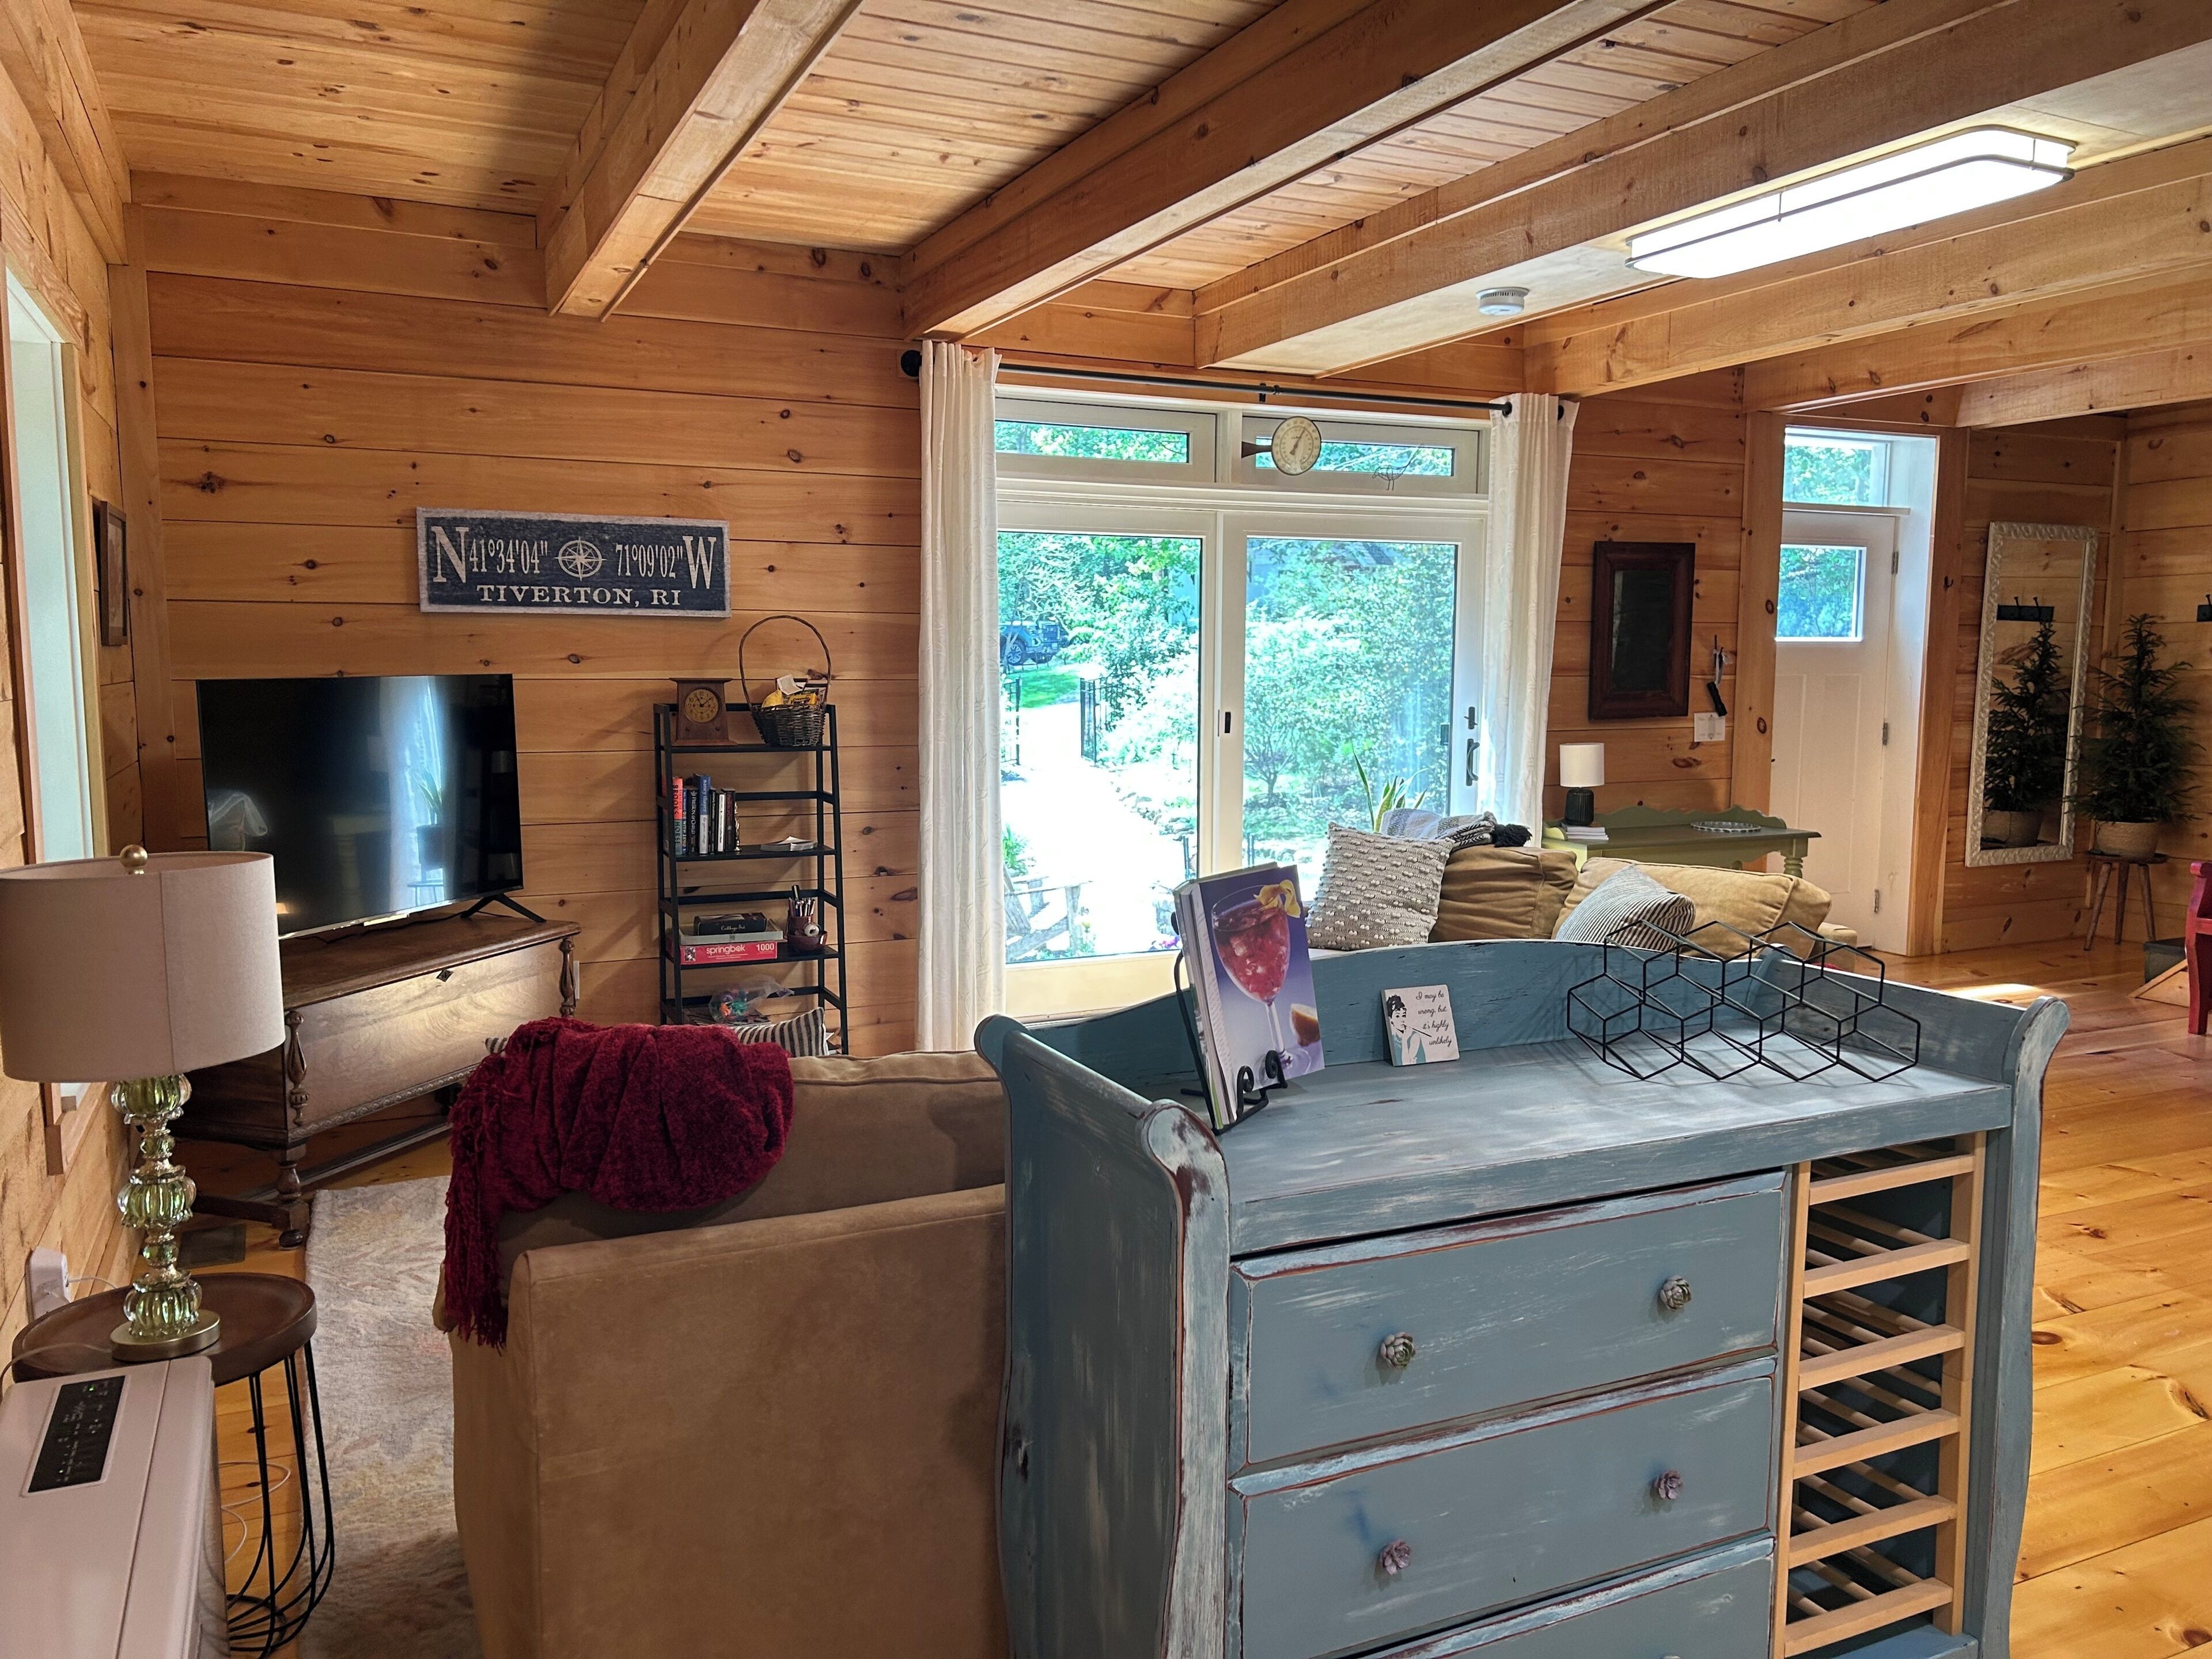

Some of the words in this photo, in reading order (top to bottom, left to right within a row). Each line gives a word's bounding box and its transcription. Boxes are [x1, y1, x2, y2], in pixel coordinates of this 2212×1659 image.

[431, 525, 469, 584] N
[682, 535, 718, 589] W
[476, 585, 639, 607] TIVERTON,
[650, 589, 681, 606] RI
[706, 944, 745, 956] springbok
[756, 943, 775, 951] 1000
[1415, 991, 1423, 1000] I
[1425, 994, 1437, 1002] may
[1438, 990, 1445, 998] be
[1431, 1020, 1449, 1032] highly
[1429, 1036, 1452, 1047] unlikely
